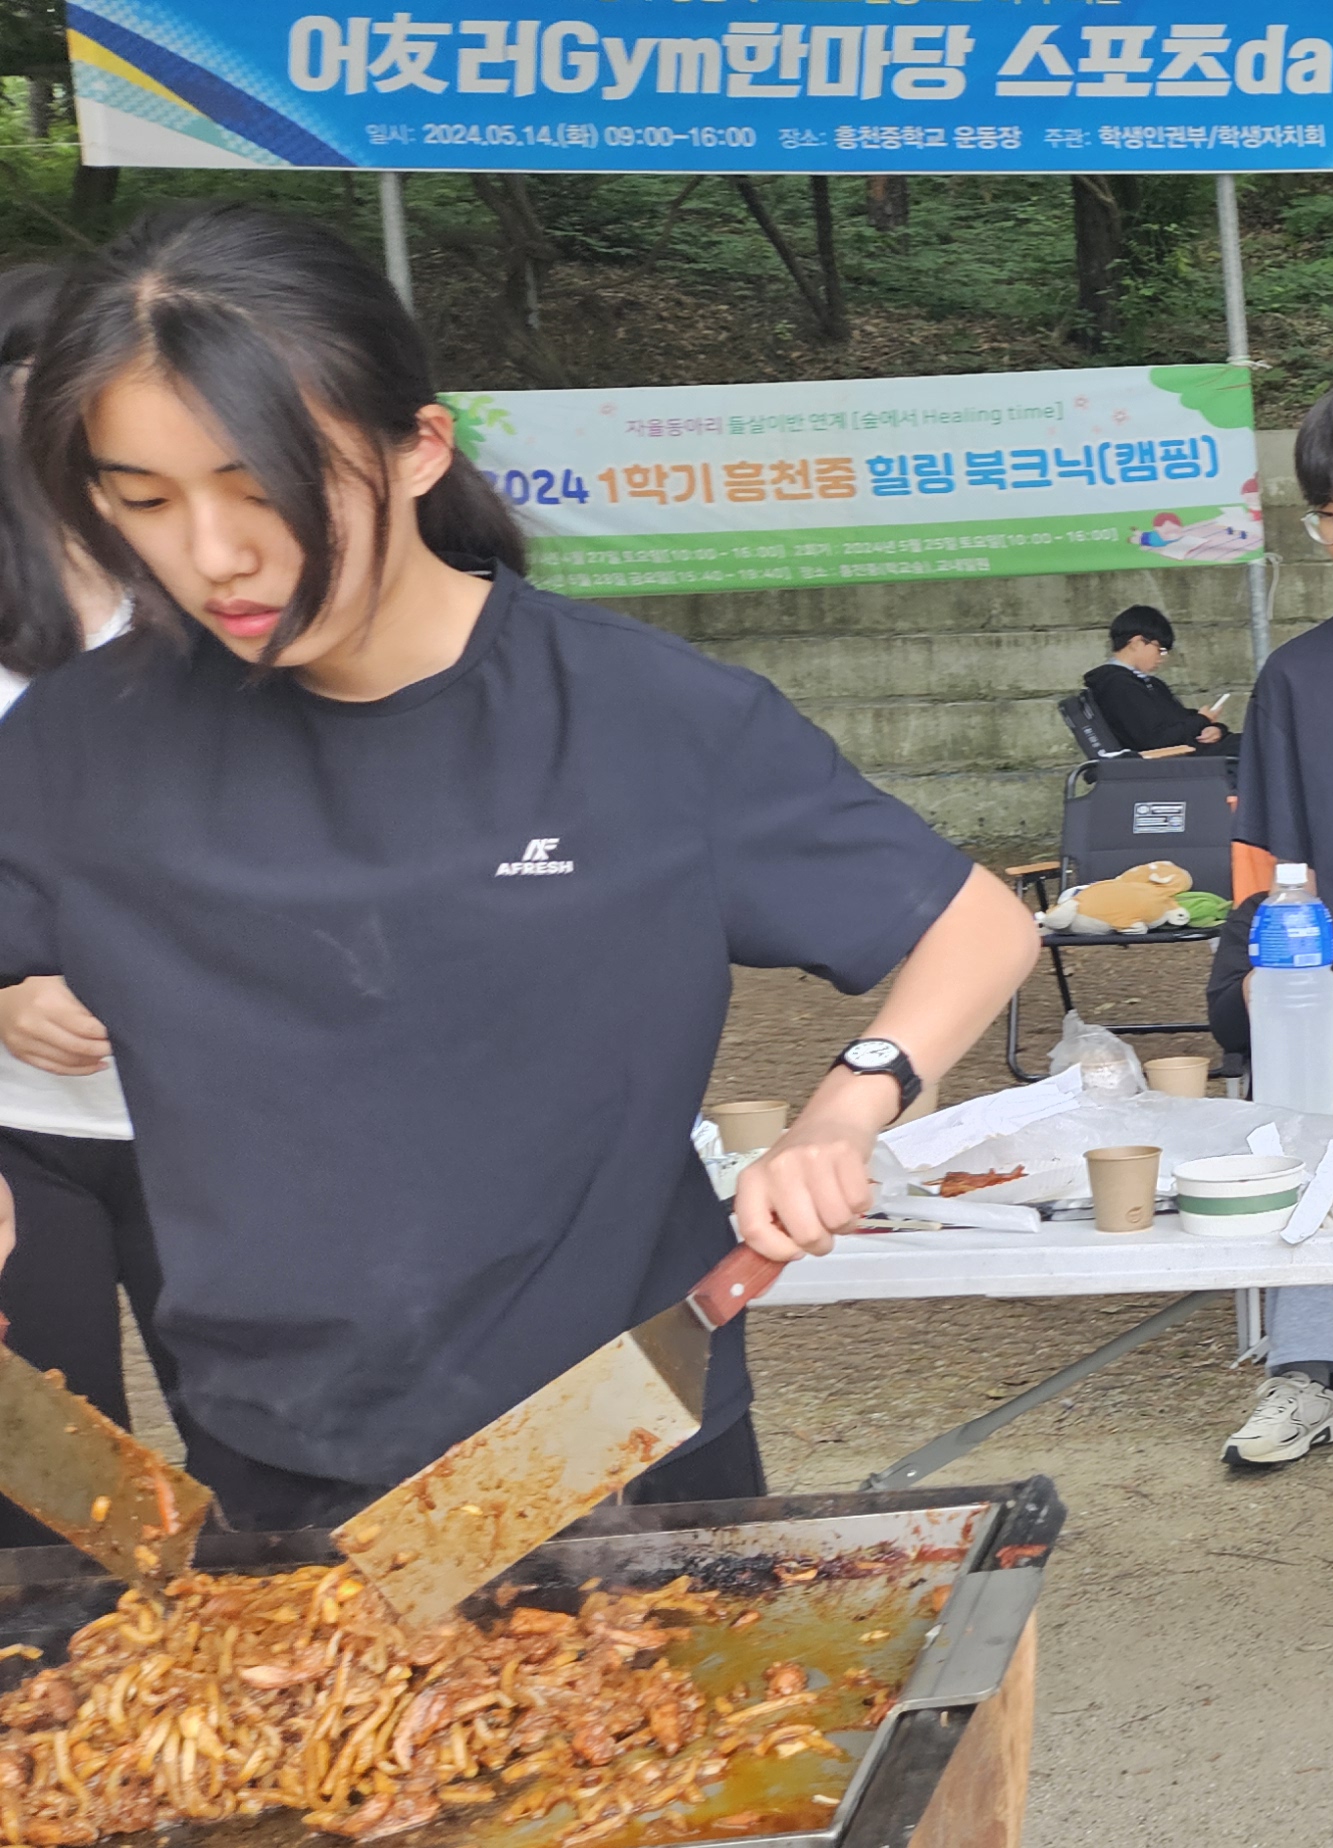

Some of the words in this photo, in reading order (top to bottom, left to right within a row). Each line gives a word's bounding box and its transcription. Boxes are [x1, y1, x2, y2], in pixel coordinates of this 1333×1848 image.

[365, 124, 415, 145] 일시:
[422, 123, 599, 149] 2024.05.14.(화)
[778, 128, 828, 149] 장소:
[834, 126, 948, 149] 흥천중학교
[953, 126, 1022, 149] 운동장
[1044, 127, 1092, 147] 주관:
[625, 415, 723, 438] 자율동아리
[923, 405, 1002, 426] Healing
[597, 461, 717, 506] 1학기
[722, 456, 859, 502] 흥천중
[866, 451, 956, 497] 힐링
[964, 434, 1221, 492] 북크닉(캠핑)
[494, 860, 574, 878] AFRESH
